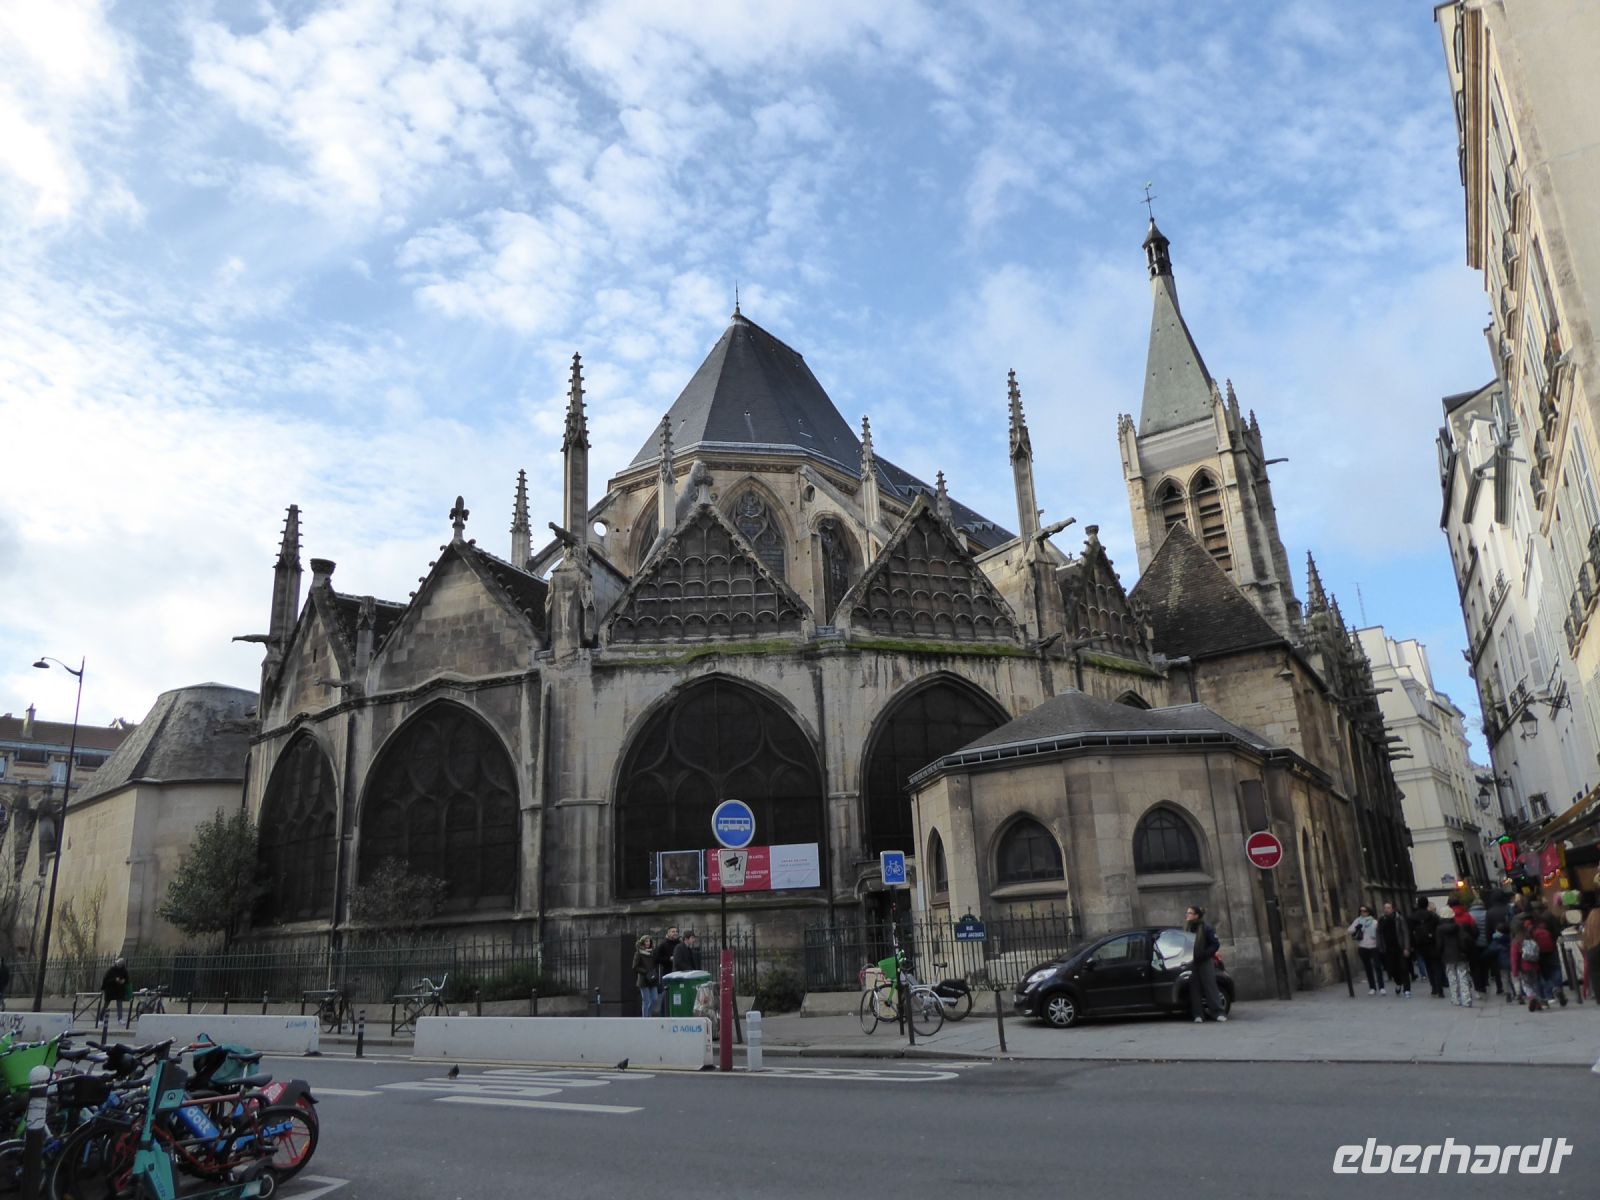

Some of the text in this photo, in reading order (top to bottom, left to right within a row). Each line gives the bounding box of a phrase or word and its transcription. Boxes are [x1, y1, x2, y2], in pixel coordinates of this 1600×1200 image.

[679, 1024, 703, 1033] AGILIS
[374, 1068, 656, 1097] BUS
[187, 1107, 211, 1137] dott
